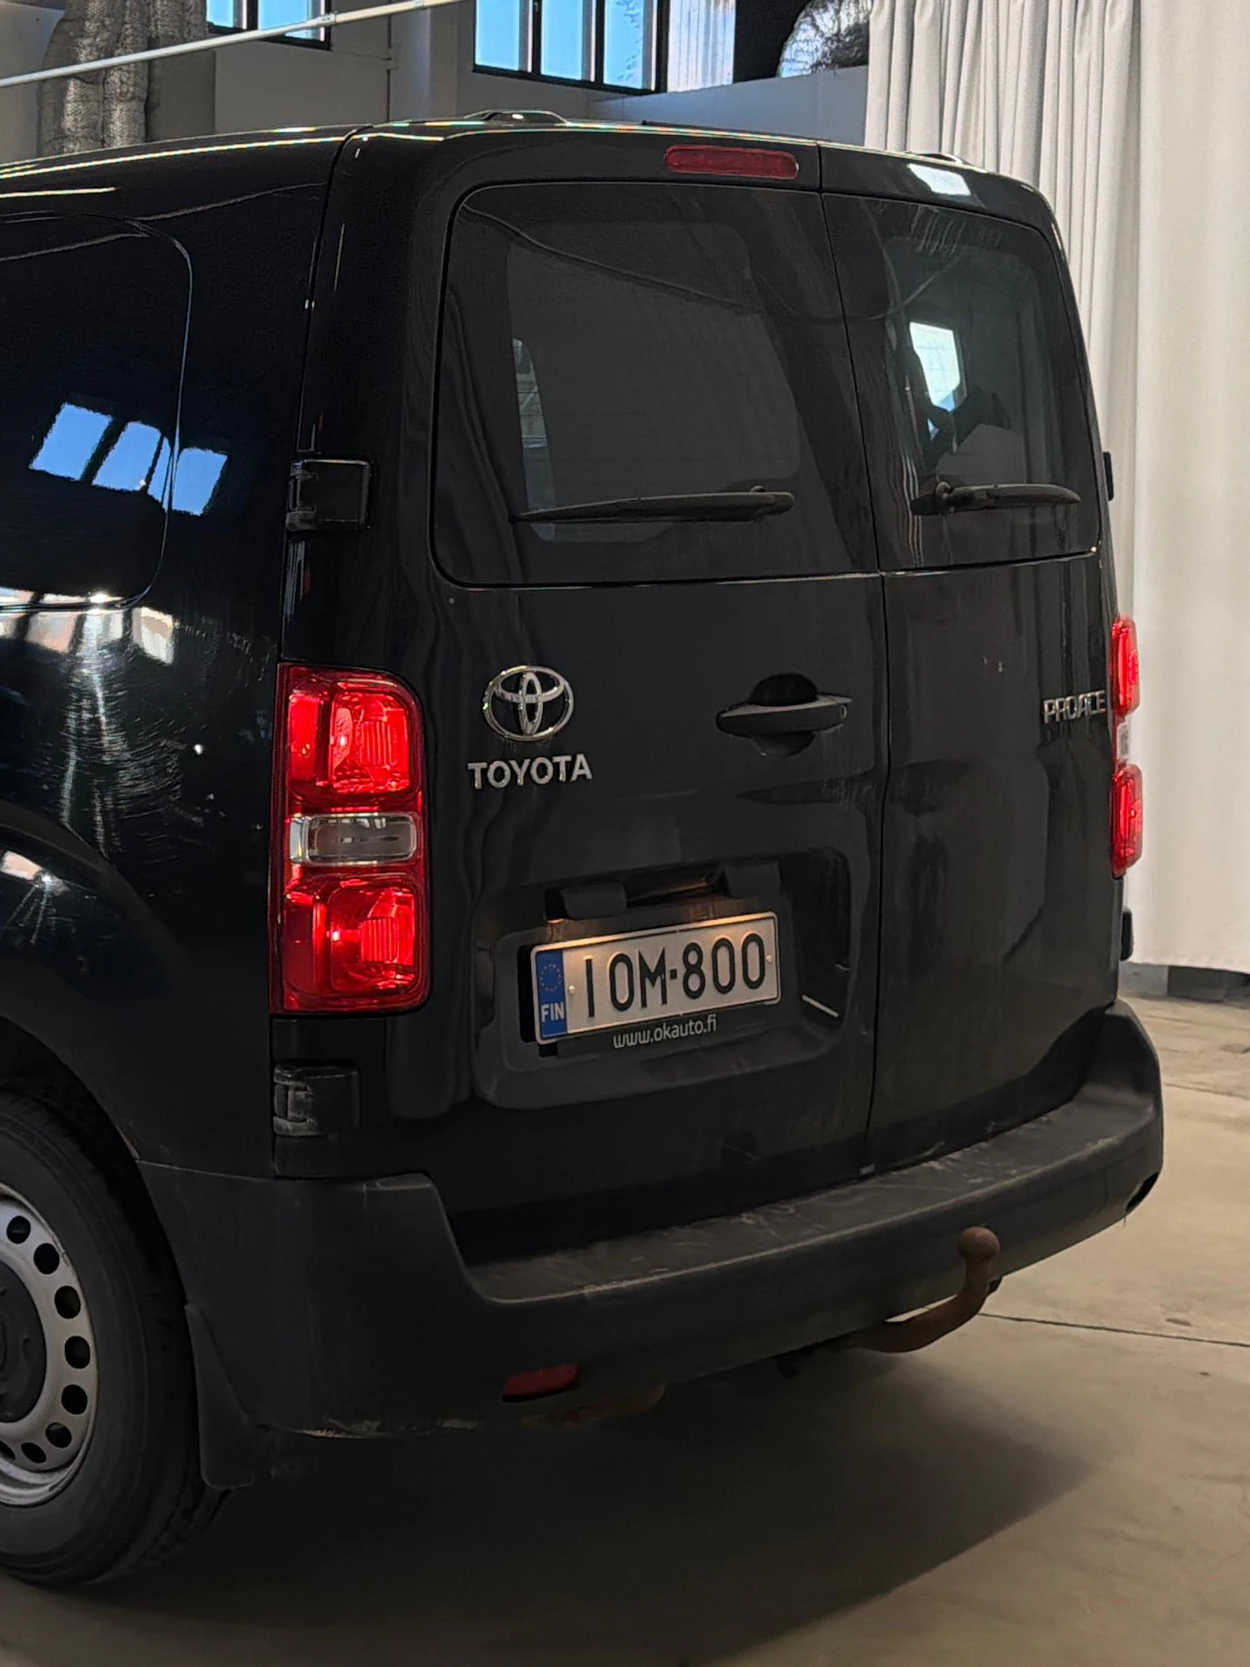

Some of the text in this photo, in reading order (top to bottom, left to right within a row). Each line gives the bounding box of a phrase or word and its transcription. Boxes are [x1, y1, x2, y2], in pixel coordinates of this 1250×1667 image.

[1043, 690, 1107, 724] PROACE
[467, 753, 592, 789] TOYOTA
[584, 932, 766, 1018] IOM-800
[540, 1001, 566, 1023] FIN
[613, 1014, 717, 1049] www.okauto.fi
